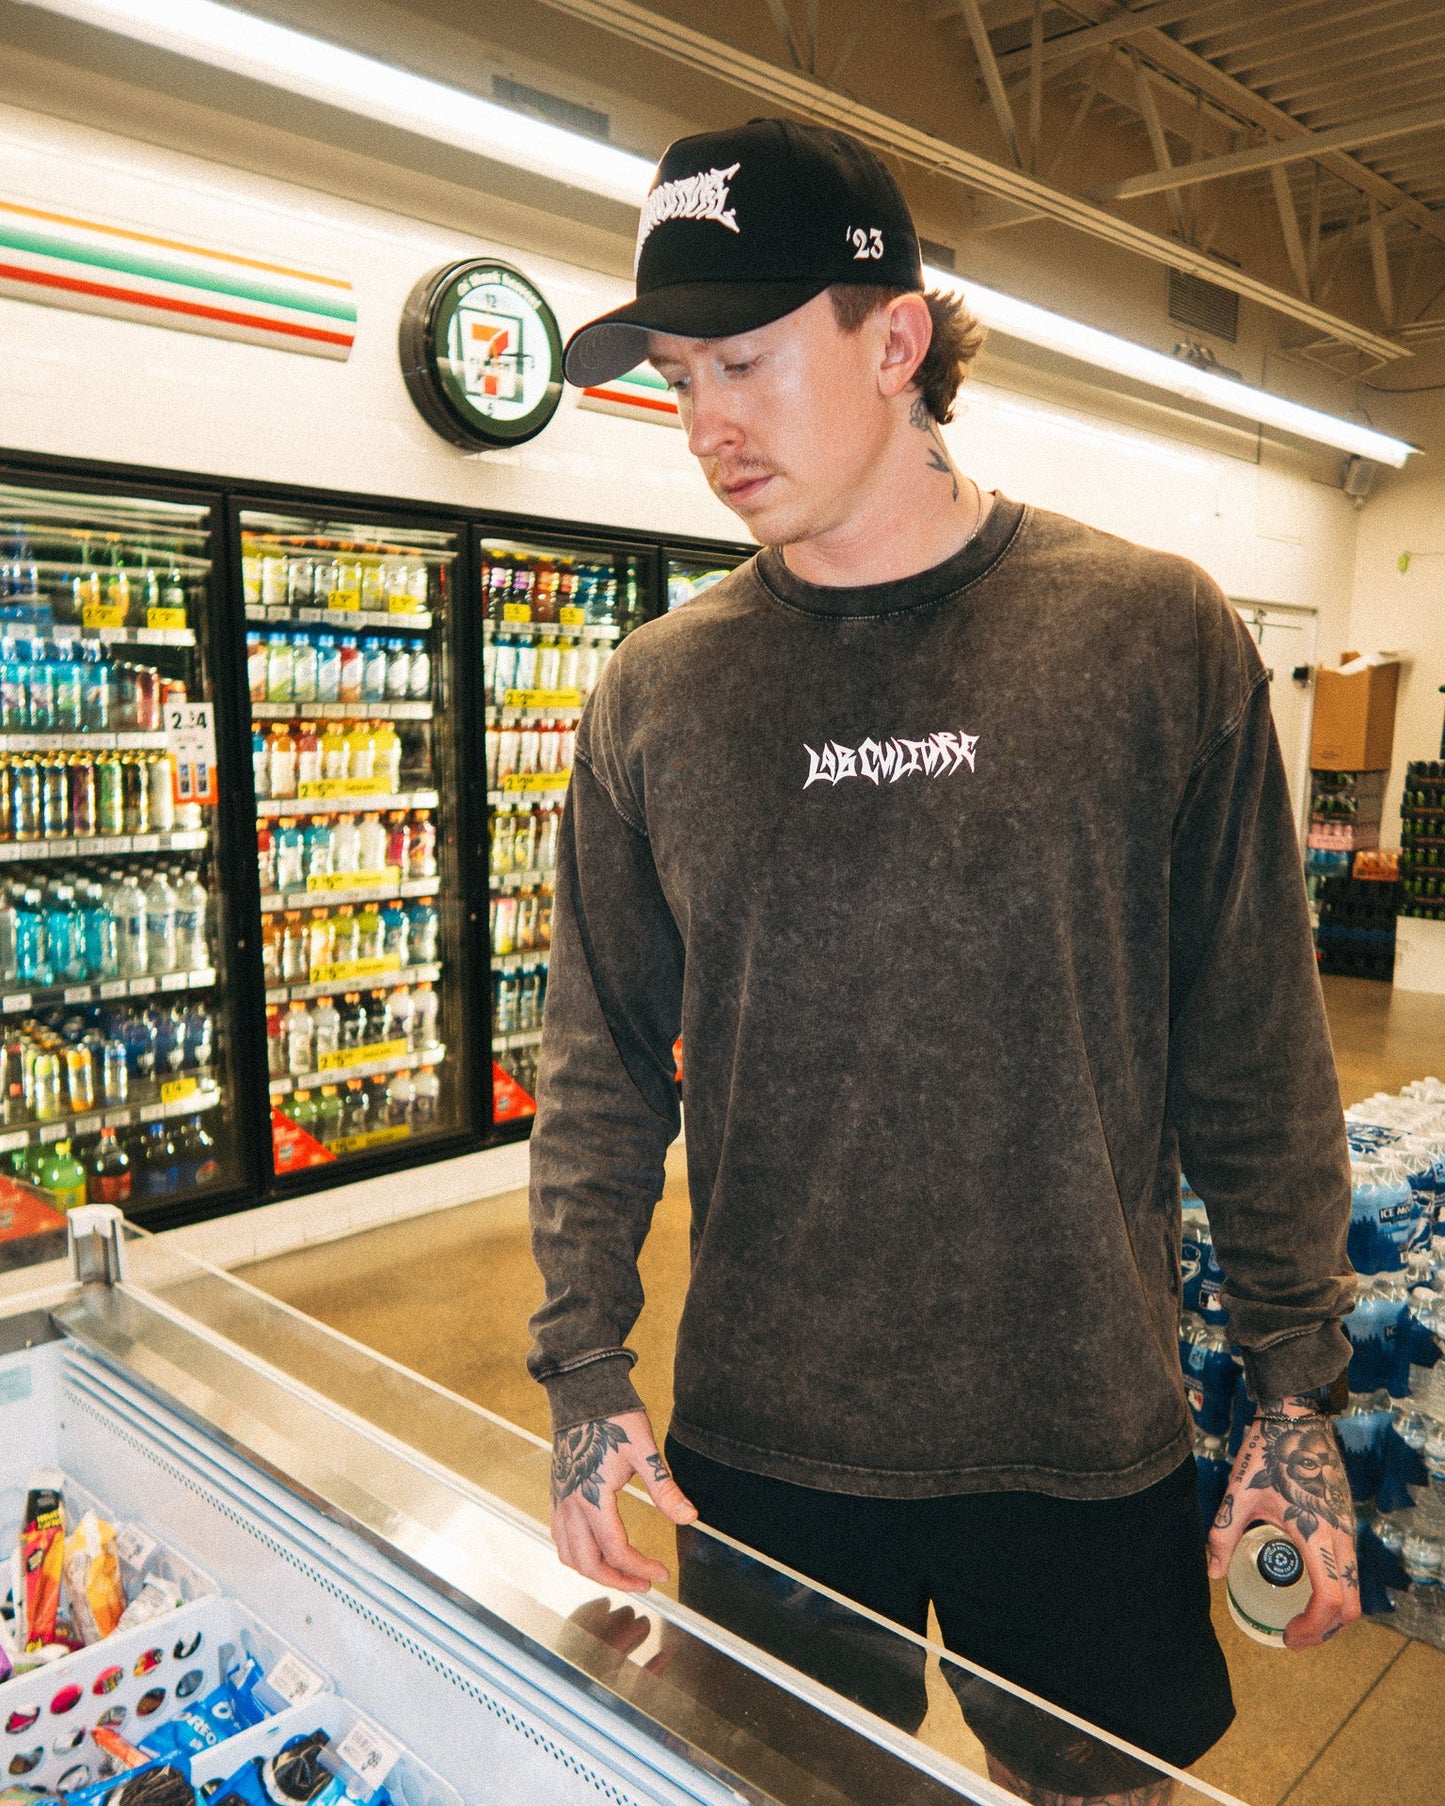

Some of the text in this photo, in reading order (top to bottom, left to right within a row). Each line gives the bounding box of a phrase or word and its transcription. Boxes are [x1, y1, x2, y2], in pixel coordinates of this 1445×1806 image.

[846, 225, 884, 260] '23
[803, 730, 980, 790] LAB CULTURE
[1380, 1208, 1394, 1219] ICE
